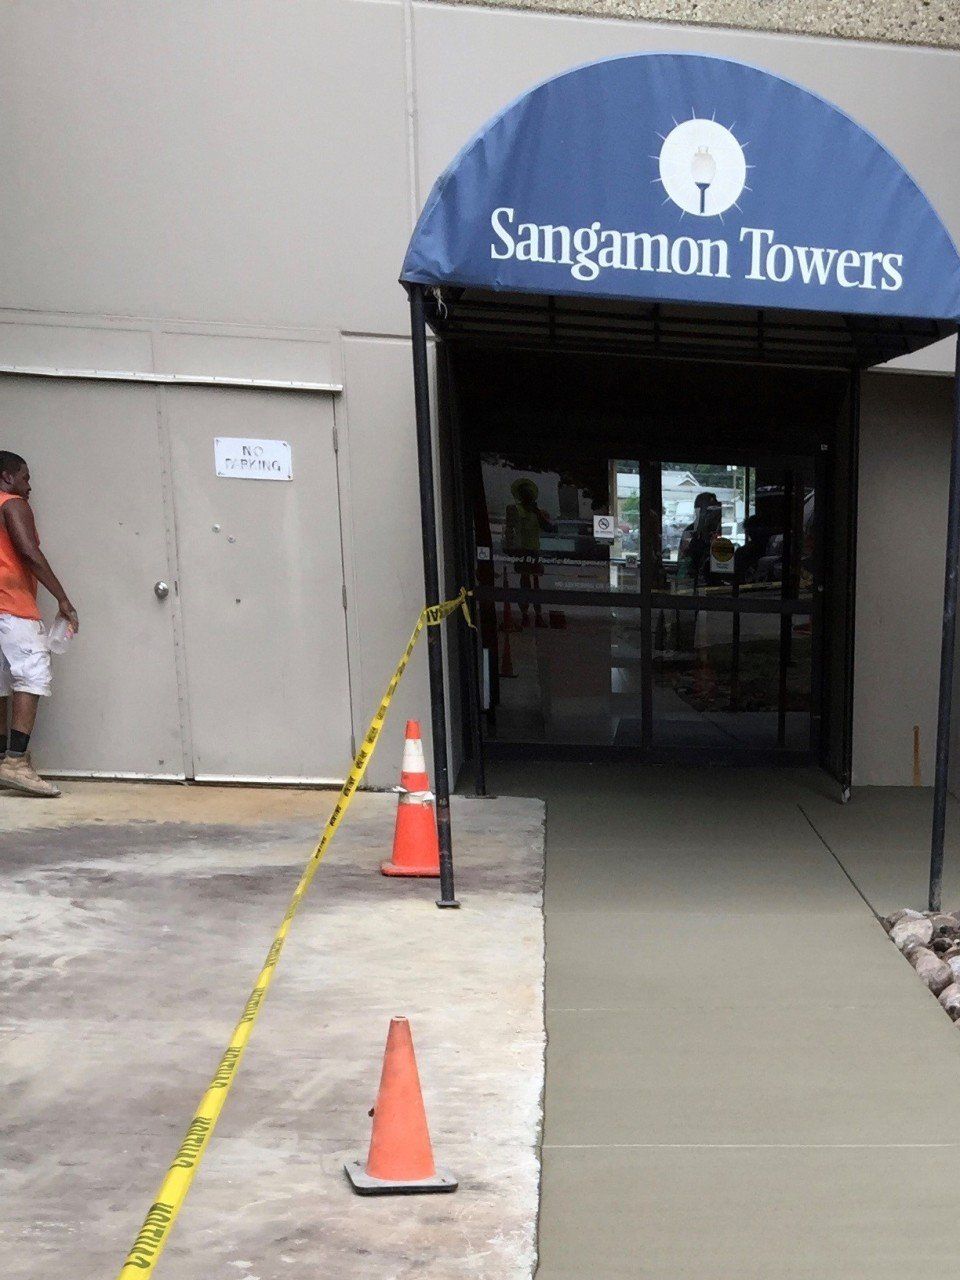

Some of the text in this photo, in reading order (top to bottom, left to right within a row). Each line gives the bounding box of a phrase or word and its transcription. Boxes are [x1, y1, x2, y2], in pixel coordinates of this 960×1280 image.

[490, 207, 904, 291] Sangamon Towers
[242, 445, 264, 457] NO
